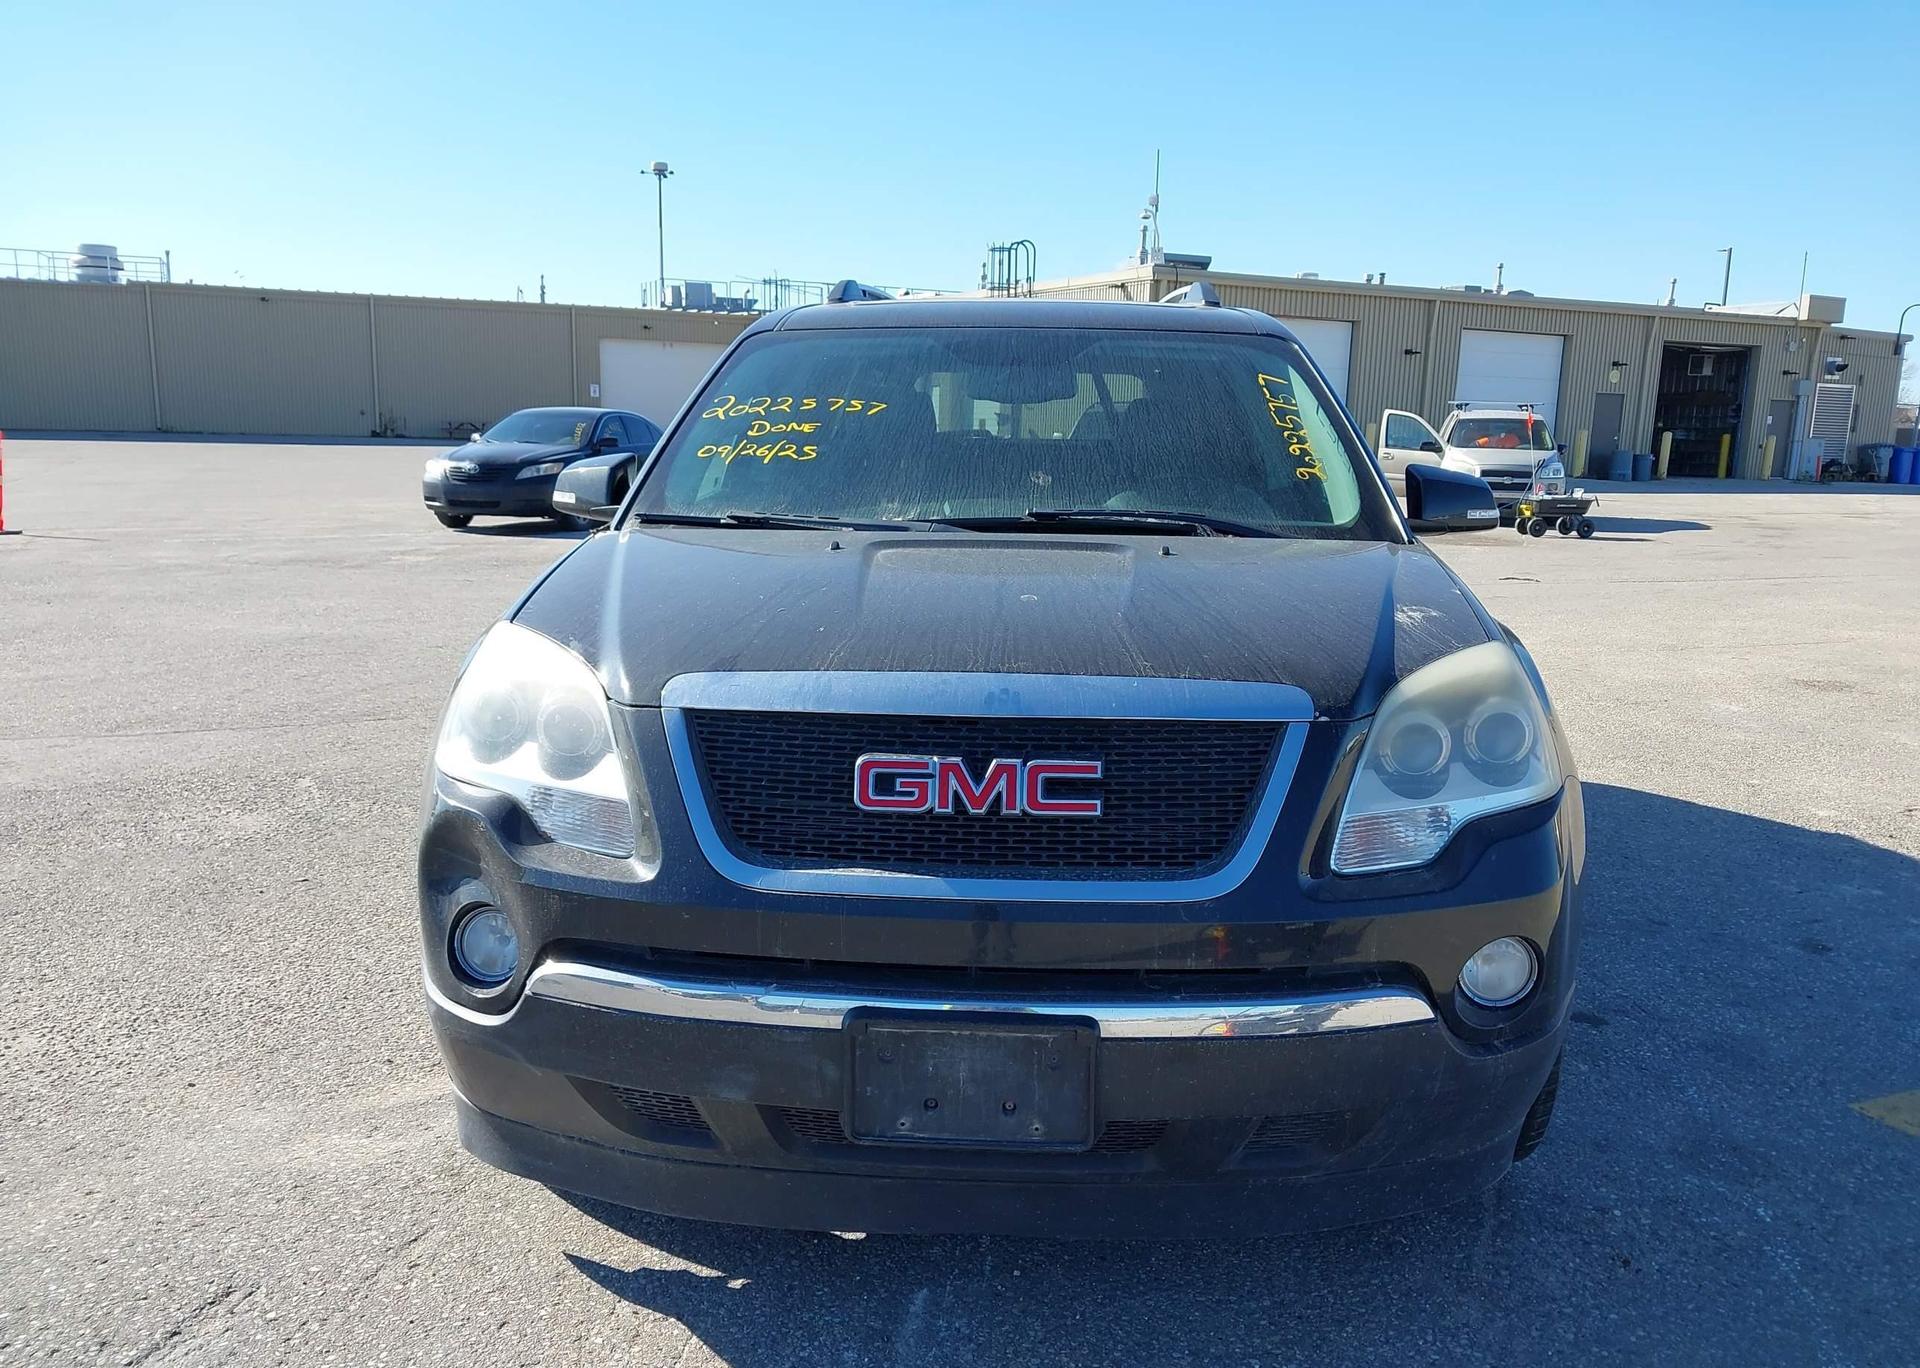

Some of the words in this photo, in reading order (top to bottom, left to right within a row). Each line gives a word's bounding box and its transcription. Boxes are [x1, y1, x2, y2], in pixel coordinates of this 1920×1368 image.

[747, 420, 822, 436] DONE
[697, 439, 818, 464] 09/26/25
[853, 752, 1104, 816] GMC
